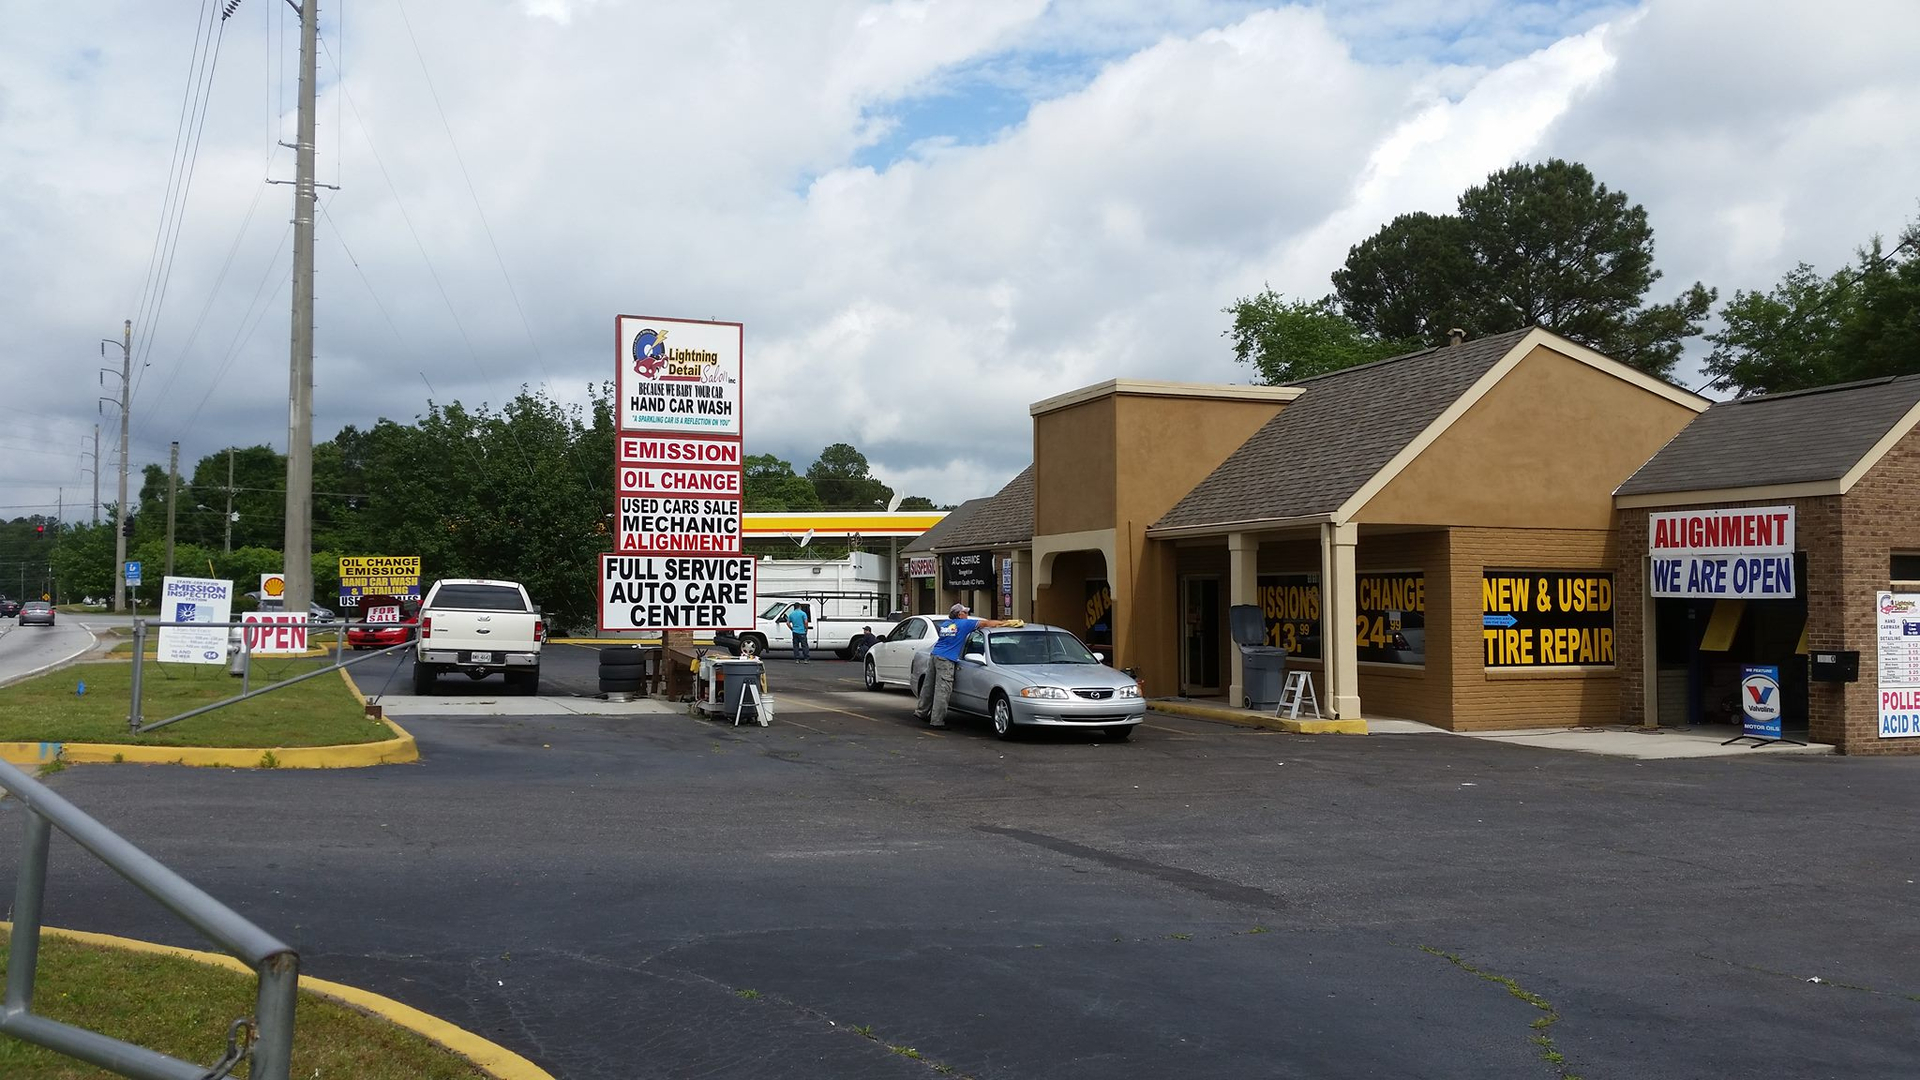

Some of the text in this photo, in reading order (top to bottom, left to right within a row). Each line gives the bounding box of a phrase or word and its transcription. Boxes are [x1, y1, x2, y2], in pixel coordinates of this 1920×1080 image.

[669, 348, 718, 365] Lightning
[668, 365, 701, 376] Detail
[700, 364, 728, 384] Salon
[638, 382, 723, 399] BECAUSE WE BABY YOUR CAR
[631, 396, 732, 415] HAND CAR WASH
[638, 415, 663, 423] SPARKLING
[684, 417, 711, 425] REFLECTION
[624, 441, 737, 462] EMISSION
[624, 470, 737, 490] OIL CHANGE
[622, 499, 737, 515] USED CARS SALE
[623, 516, 737, 533] MECHANIC
[1654, 514, 1788, 548] ALIGNMENT
[623, 533, 736, 551] ALIGNMENT
[342, 558, 419, 567] OIL CHANGE
[346, 567, 415, 575] EMISSION
[607, 558, 751, 581] FULL SERVICE
[342, 577, 418, 587] HAND CAR WASH
[1654, 558, 1791, 594] WE ARE OPEN
[167, 591, 226, 600] INSPECTION
[168, 583, 226, 594] EMISSION
[362, 586, 409, 595] DETAILING
[609, 582, 748, 604] AUTO CARE
[1360, 578, 1425, 612] CHANGE
[1483, 578, 1611, 612] NEW & USED
[630, 604, 727, 626] CENTER
[243, 616, 306, 649] OPEN
[1484, 628, 1613, 664] TIRE REPAIR
[1748, 705, 1774, 713] Valvoline
[1883, 715, 1908, 733] ACID
